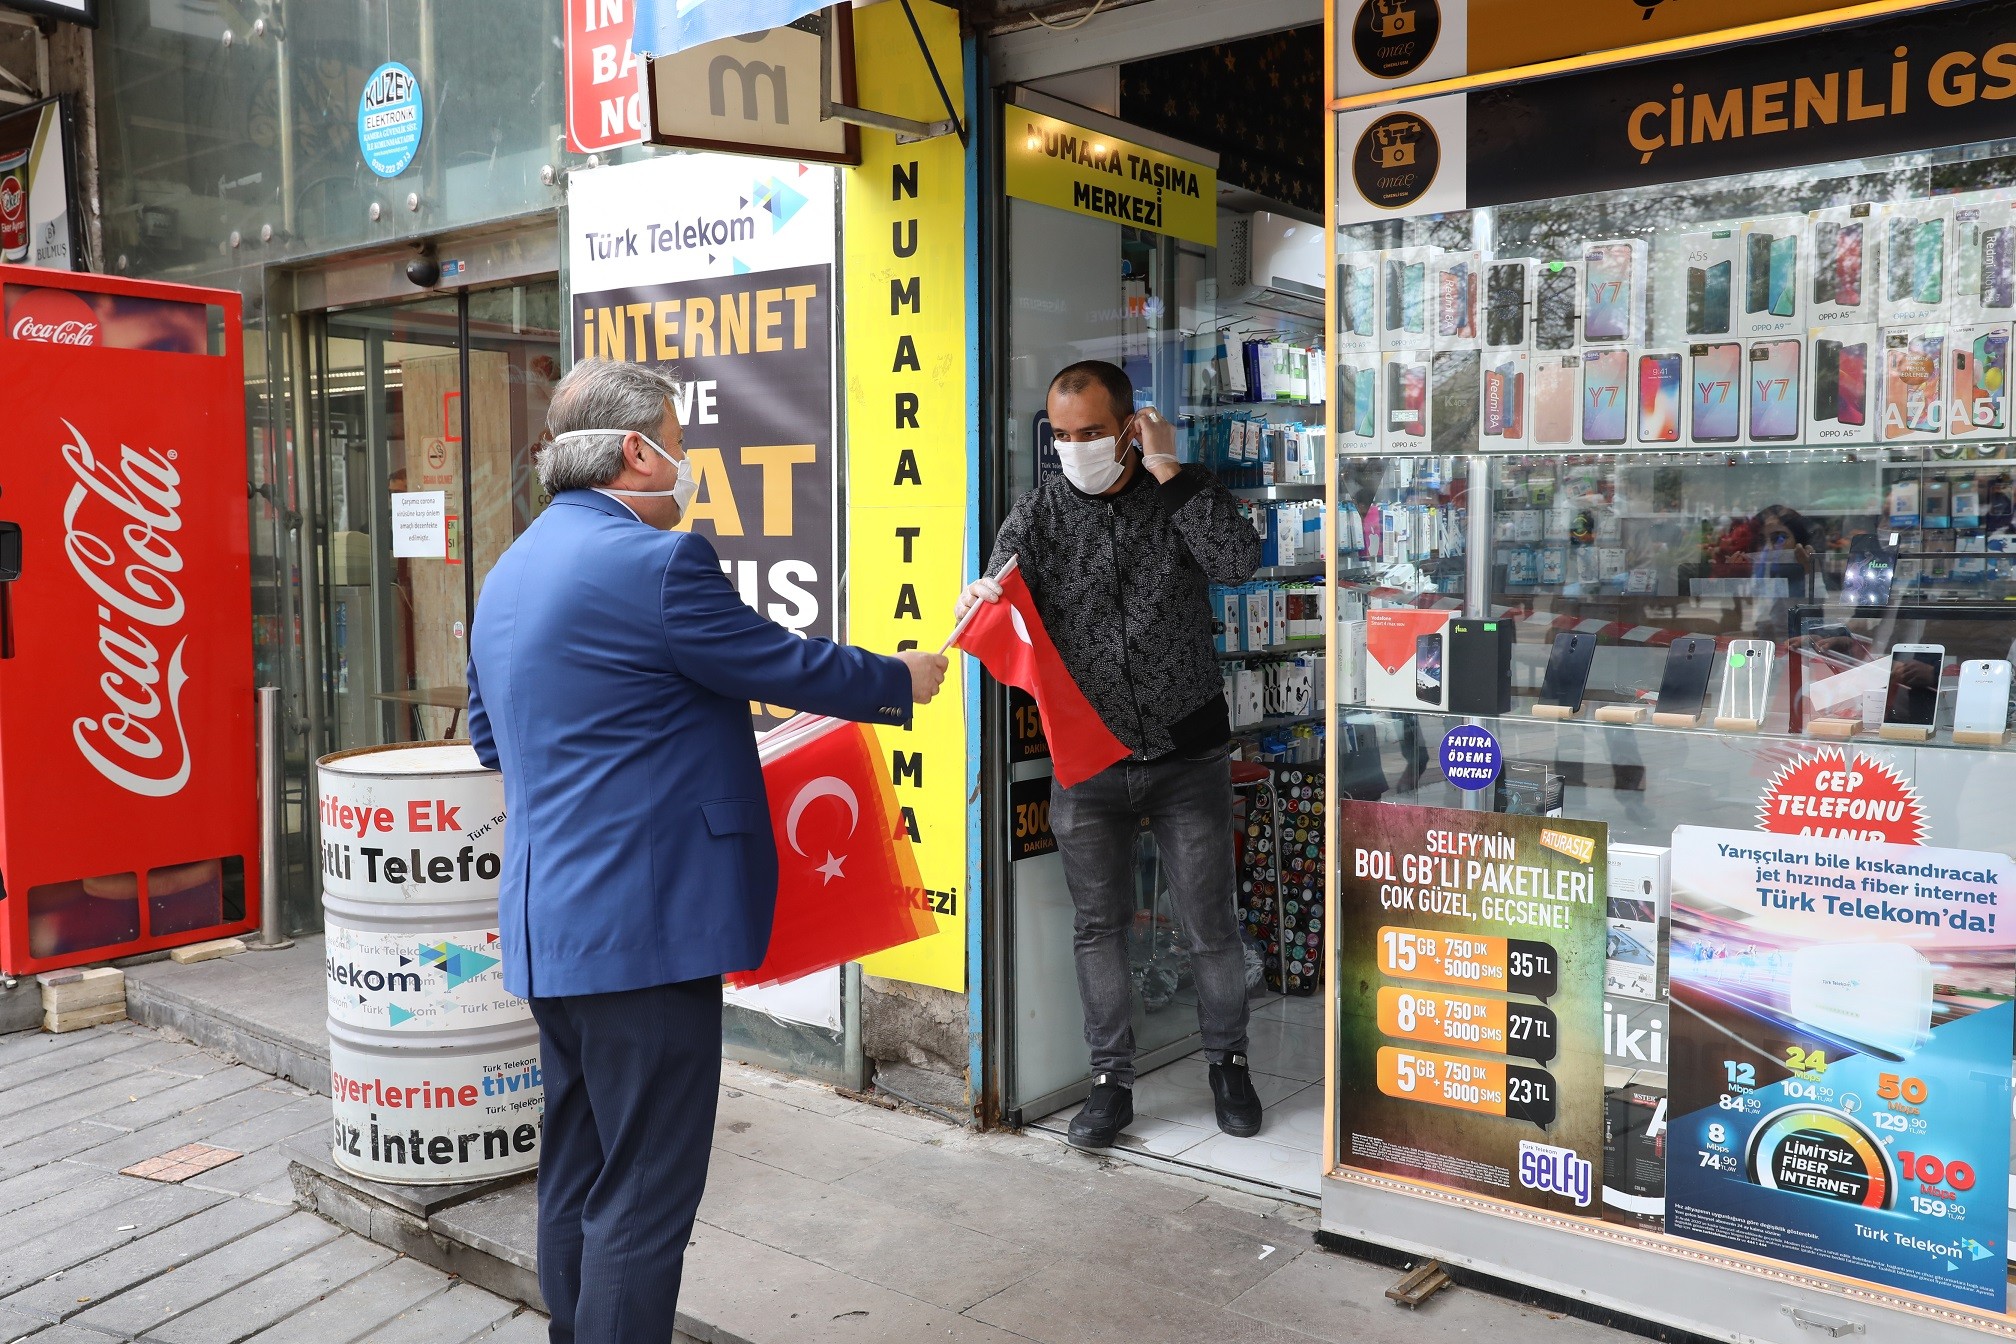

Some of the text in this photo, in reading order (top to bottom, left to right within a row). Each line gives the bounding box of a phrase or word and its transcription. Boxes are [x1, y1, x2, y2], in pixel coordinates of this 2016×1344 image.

[365, 72, 414, 109] KUZEY
[1627, 46, 1908, 163] ÇİMENLİ
[1027, 123, 1200, 199] NUMARA TAŞIMA
[1073, 181, 1163, 228] MERKEZİ
[586, 214, 755, 262] Türk Telekom
[37, 243, 67, 261] BULMUŞ
[1591, 281, 1623, 303] Y7
[1751, 324, 1772, 332] OPPO
[1818, 312, 1838, 321] OPPO
[1489, 377, 1501, 412] Redmi
[1588, 386, 1620, 408] Y7
[1698, 381, 1732, 404] Y7
[1756, 379, 1791, 402] Y7
[1391, 441, 1407, 449] OPPO
[1819, 430, 1841, 438] OPPO
[1447, 736, 1492, 748] FATURA
[1448, 750, 1493, 764] ÖDEME
[1447, 766, 1493, 780] NOKTASI
[1815, 770, 1864, 793] CEP
[407, 799, 463, 833] Ek
[1016, 799, 1050, 838] 300
[1777, 794, 1906, 823] TELEFONU
[466, 810, 508, 842] Türk Tel
[1541, 827, 1594, 861] FATURASIZ
[360, 845, 501, 884] Telefo
[1717, 842, 1998, 885] Yarışçıları bile kıskandıracak
[1355, 848, 1397, 882] BOL
[1466, 860, 1595, 904] PAKETLERİ
[1756, 866, 1998, 906] jet hızında fiber internet
[1380, 884, 1571, 930] ÇOK GÜZEL, GEÇSENE!
[1756, 886, 1816, 914] Türk
[384, 945, 421, 957] Teleko
[1383, 931, 1551, 978] 15 GB 750 DK 35 TL
[1444, 958, 1503, 981] 5000 SMS
[461, 997, 531, 1014] Türk Teleko
[1397, 993, 1551, 1041] 8 GB 750 DK 27 TL
[1443, 1020, 1502, 1043] 5000 SMS
[483, 1056, 537, 1073] Türk Telekom
[1785, 1046, 1828, 1074] 24
[1396, 1053, 1550, 1104] 5 GB 750 DK 23 TL
[1723, 1060, 1757, 1087] 12
[1794, 1071, 1822, 1083] Mbps
[1443, 1082, 1502, 1104] 5000 SMS
[1728, 1083, 1754, 1095] Mbps
[1876, 1072, 1928, 1105] 50
[485, 1104, 507, 1115] Türk
[1887, 1100, 1921, 1115] Mbps
[1708, 1123, 1726, 1144] 8
[1706, 1142, 1730, 1153] Mbps
[1784, 1140, 1855, 1165] LİMİTSİZ
[1782, 1155, 1829, 1175] FİBER
[1897, 1150, 1977, 1192] 100
[1779, 1167, 1861, 1196] İNTERNET
[1920, 1183, 1957, 1201] Mbps
[1854, 1223, 1889, 1243] Türk
[1893, 1232, 1963, 1259] Telekom
